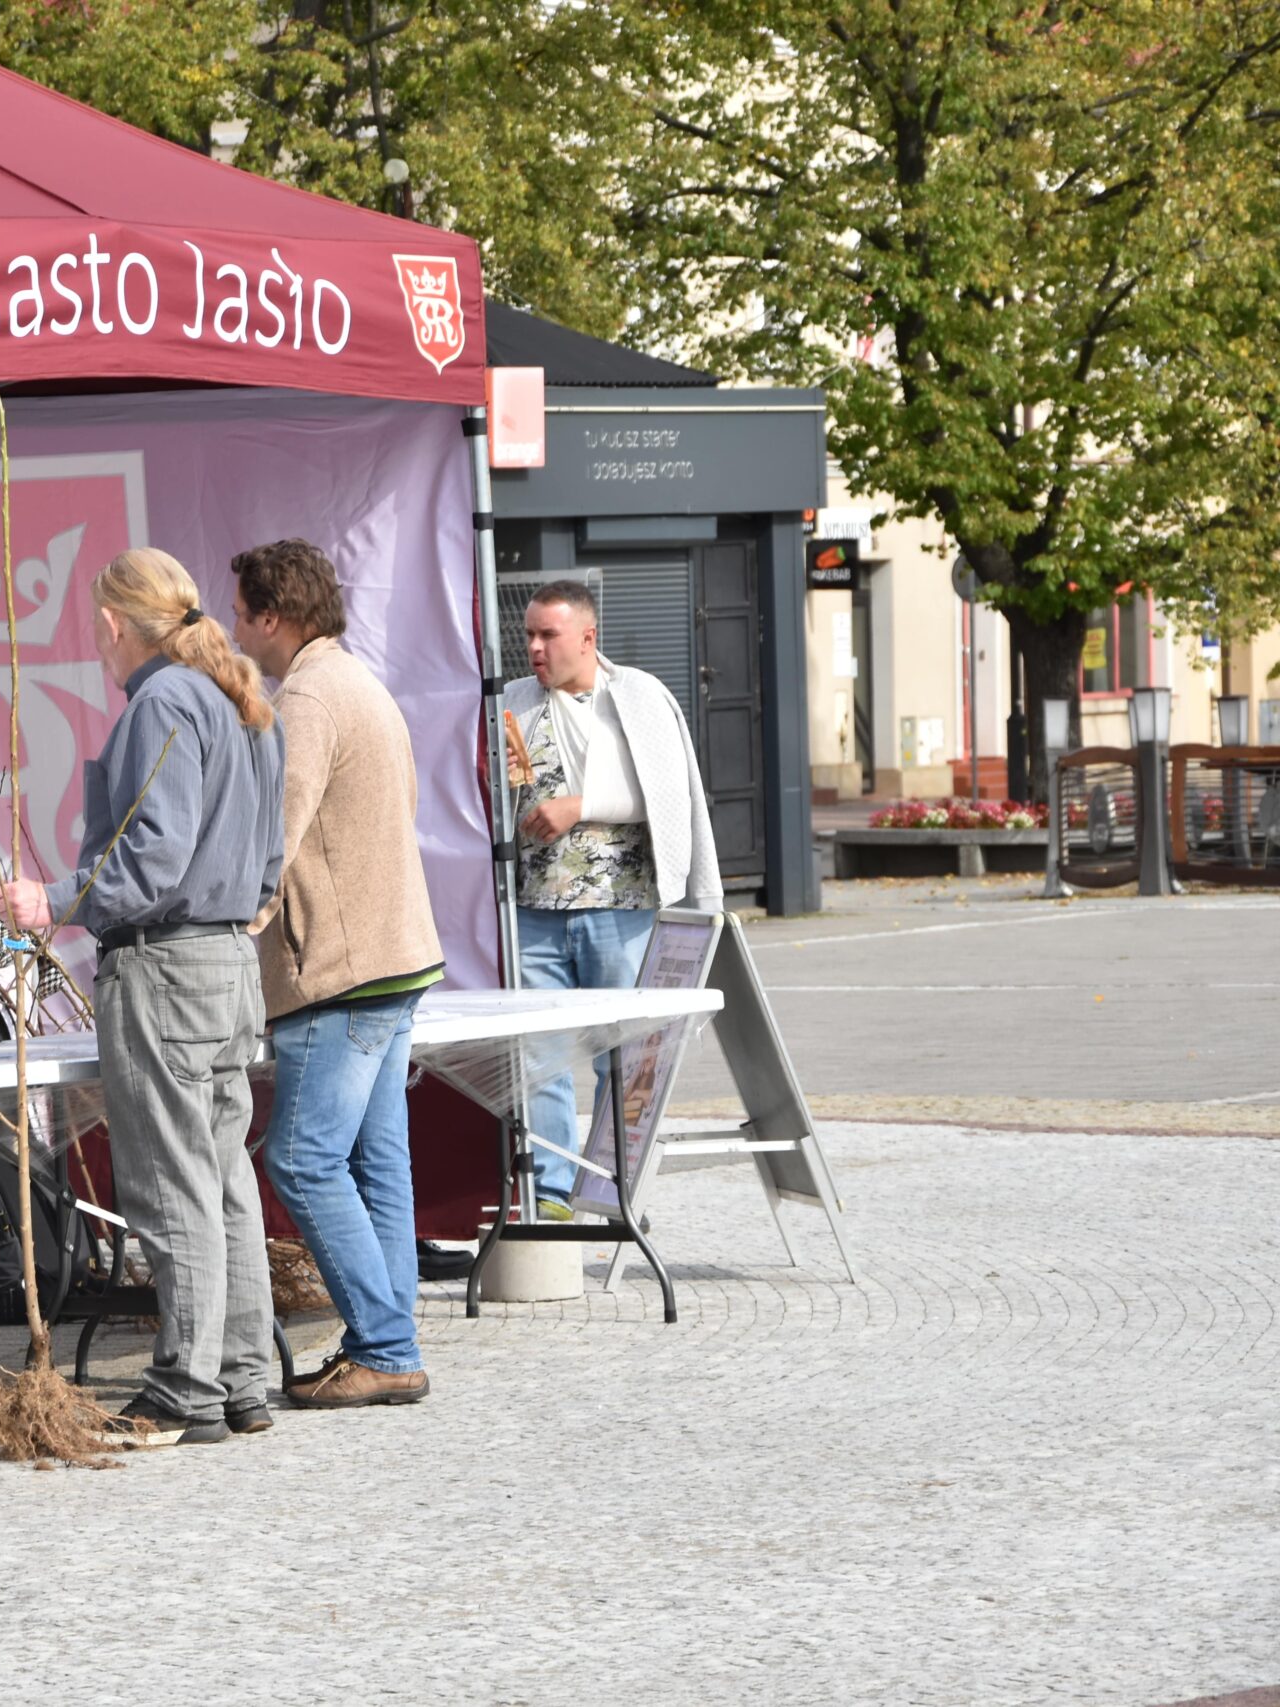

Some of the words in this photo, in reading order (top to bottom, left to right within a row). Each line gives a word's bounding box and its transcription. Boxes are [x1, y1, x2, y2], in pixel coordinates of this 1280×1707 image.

[183, 239, 351, 355] Jasło
[643, 428, 680, 448] starter
[660, 460, 694, 479] konto
